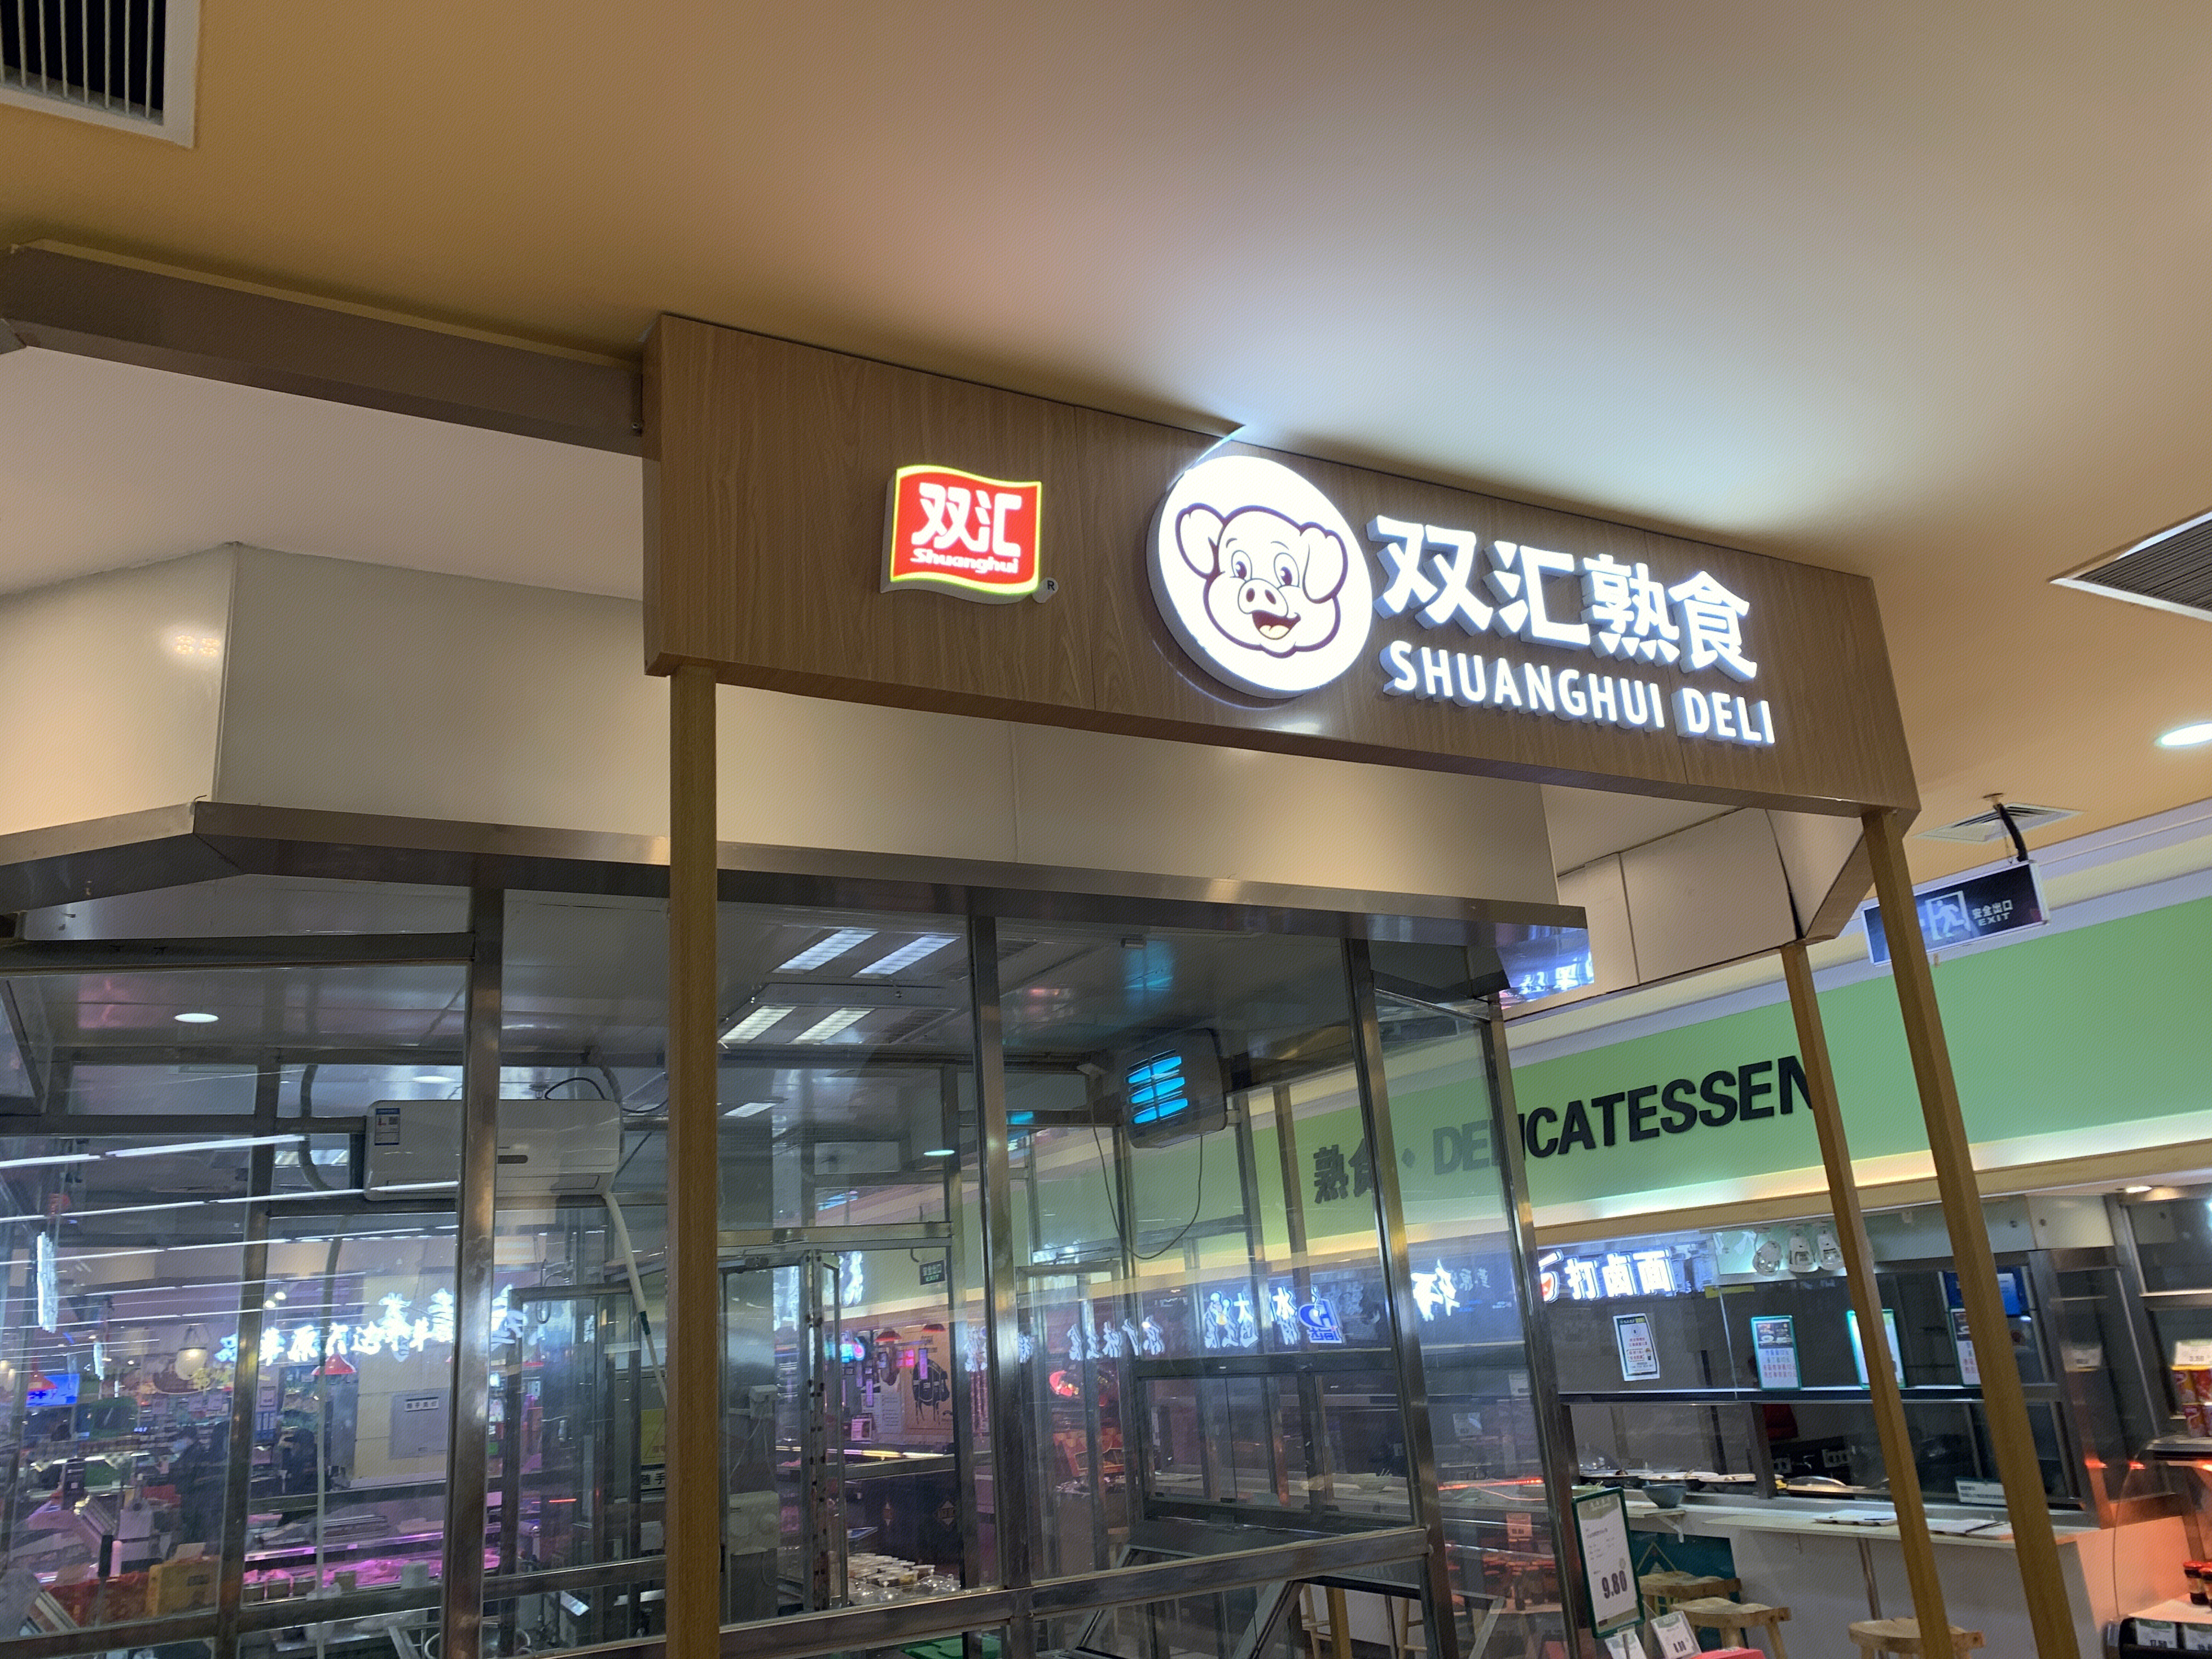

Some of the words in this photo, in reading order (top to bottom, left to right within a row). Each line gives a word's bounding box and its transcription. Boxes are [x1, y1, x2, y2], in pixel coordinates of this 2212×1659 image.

[911, 482, 1022, 556] 双汇
[910, 549, 1019, 574] Shuanghui
[1372, 515, 1757, 680] 双汇熟食
[1386, 640, 1666, 729] SHUANGHUI
[1679, 687, 1775, 744] DELI
[1972, 900, 2014, 919] 安全出口
[1978, 912, 2011, 927] EXIT
[1565, 1248, 1674, 1300] 打卤面
[1601, 1570, 1628, 1600] 9.80
